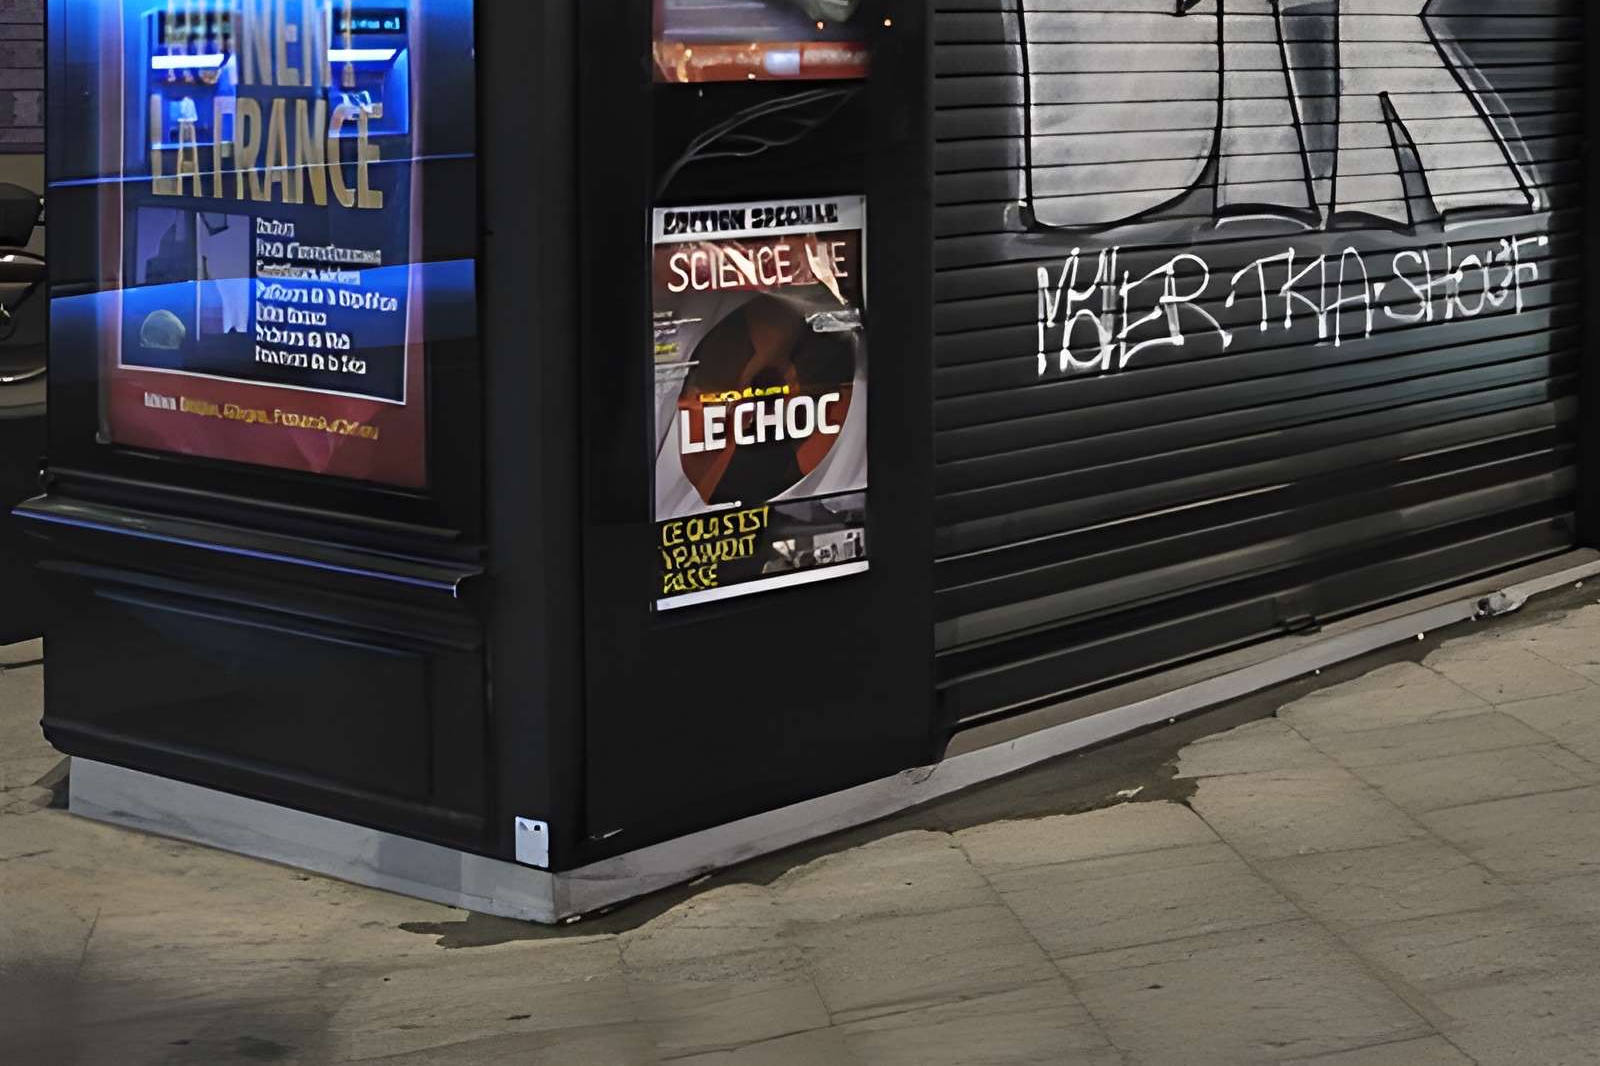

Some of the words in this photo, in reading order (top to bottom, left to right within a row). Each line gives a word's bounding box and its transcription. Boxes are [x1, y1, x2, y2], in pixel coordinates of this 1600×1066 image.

[213, 96, 384, 209] FRANCE
[681, 405, 727, 455] LE
[733, 392, 841, 446] CHOC
